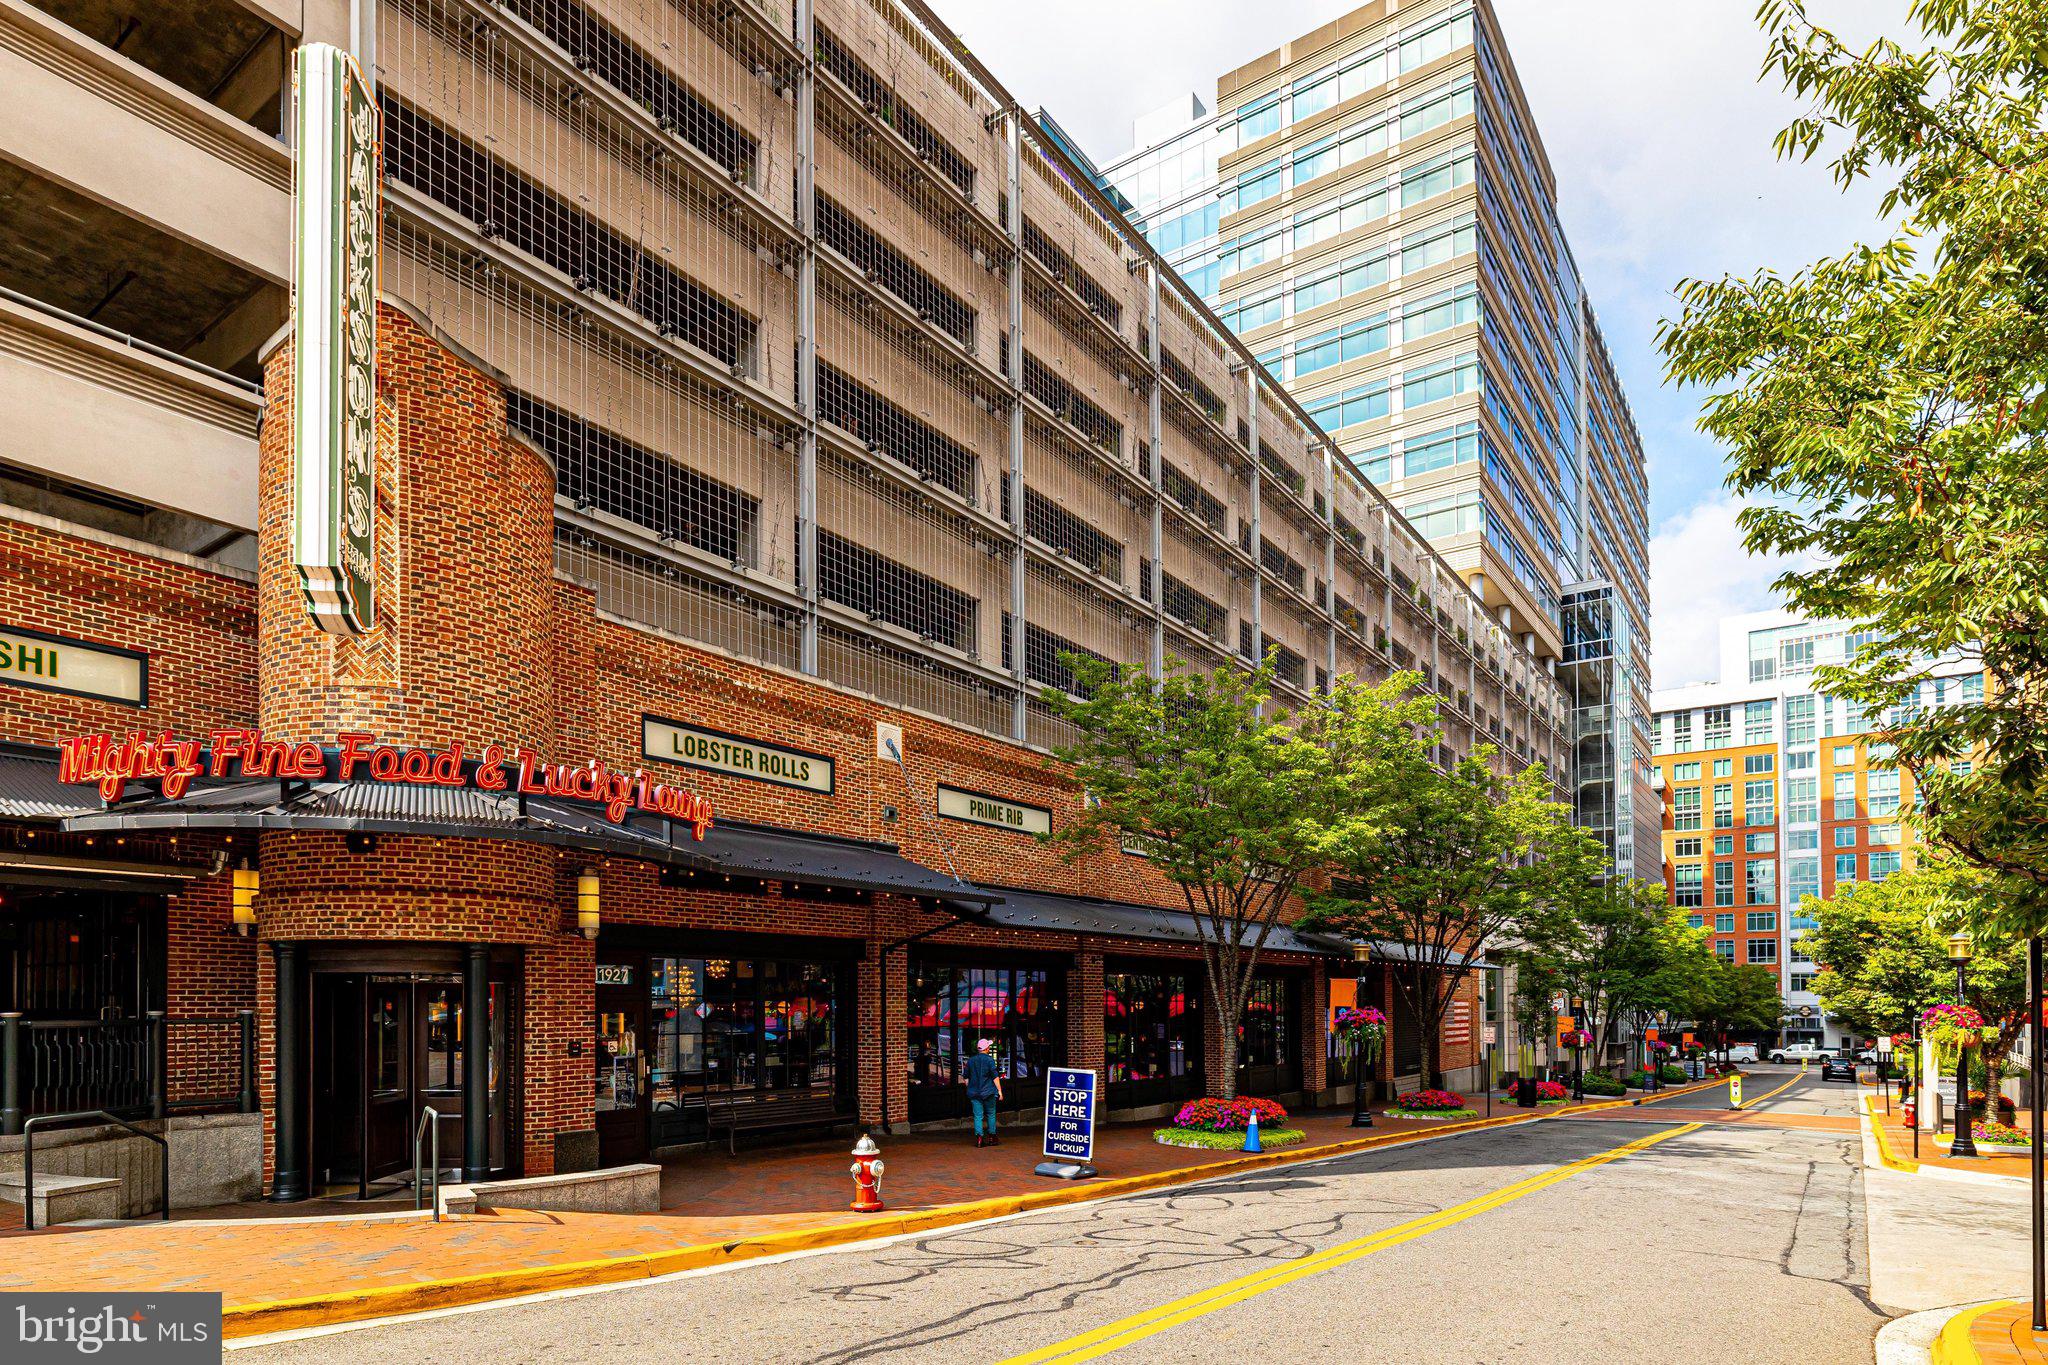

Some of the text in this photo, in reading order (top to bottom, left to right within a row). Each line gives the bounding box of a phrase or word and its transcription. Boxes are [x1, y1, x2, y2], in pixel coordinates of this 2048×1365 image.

[672, 732, 810, 782] LOBSTER ROLLS
[58, 728, 714, 842] Mighty Fine Food & Lucky Lounge
[969, 799, 1024, 826] PRIME RIB
[1053, 1089, 1087, 1102] STOP
[1052, 1104, 1086, 1117] HERE
[1060, 1121, 1078, 1131] FOR
[1048, 1131, 1089, 1143] CURBSIDE
[1053, 1143, 1085, 1153] PICKUP
